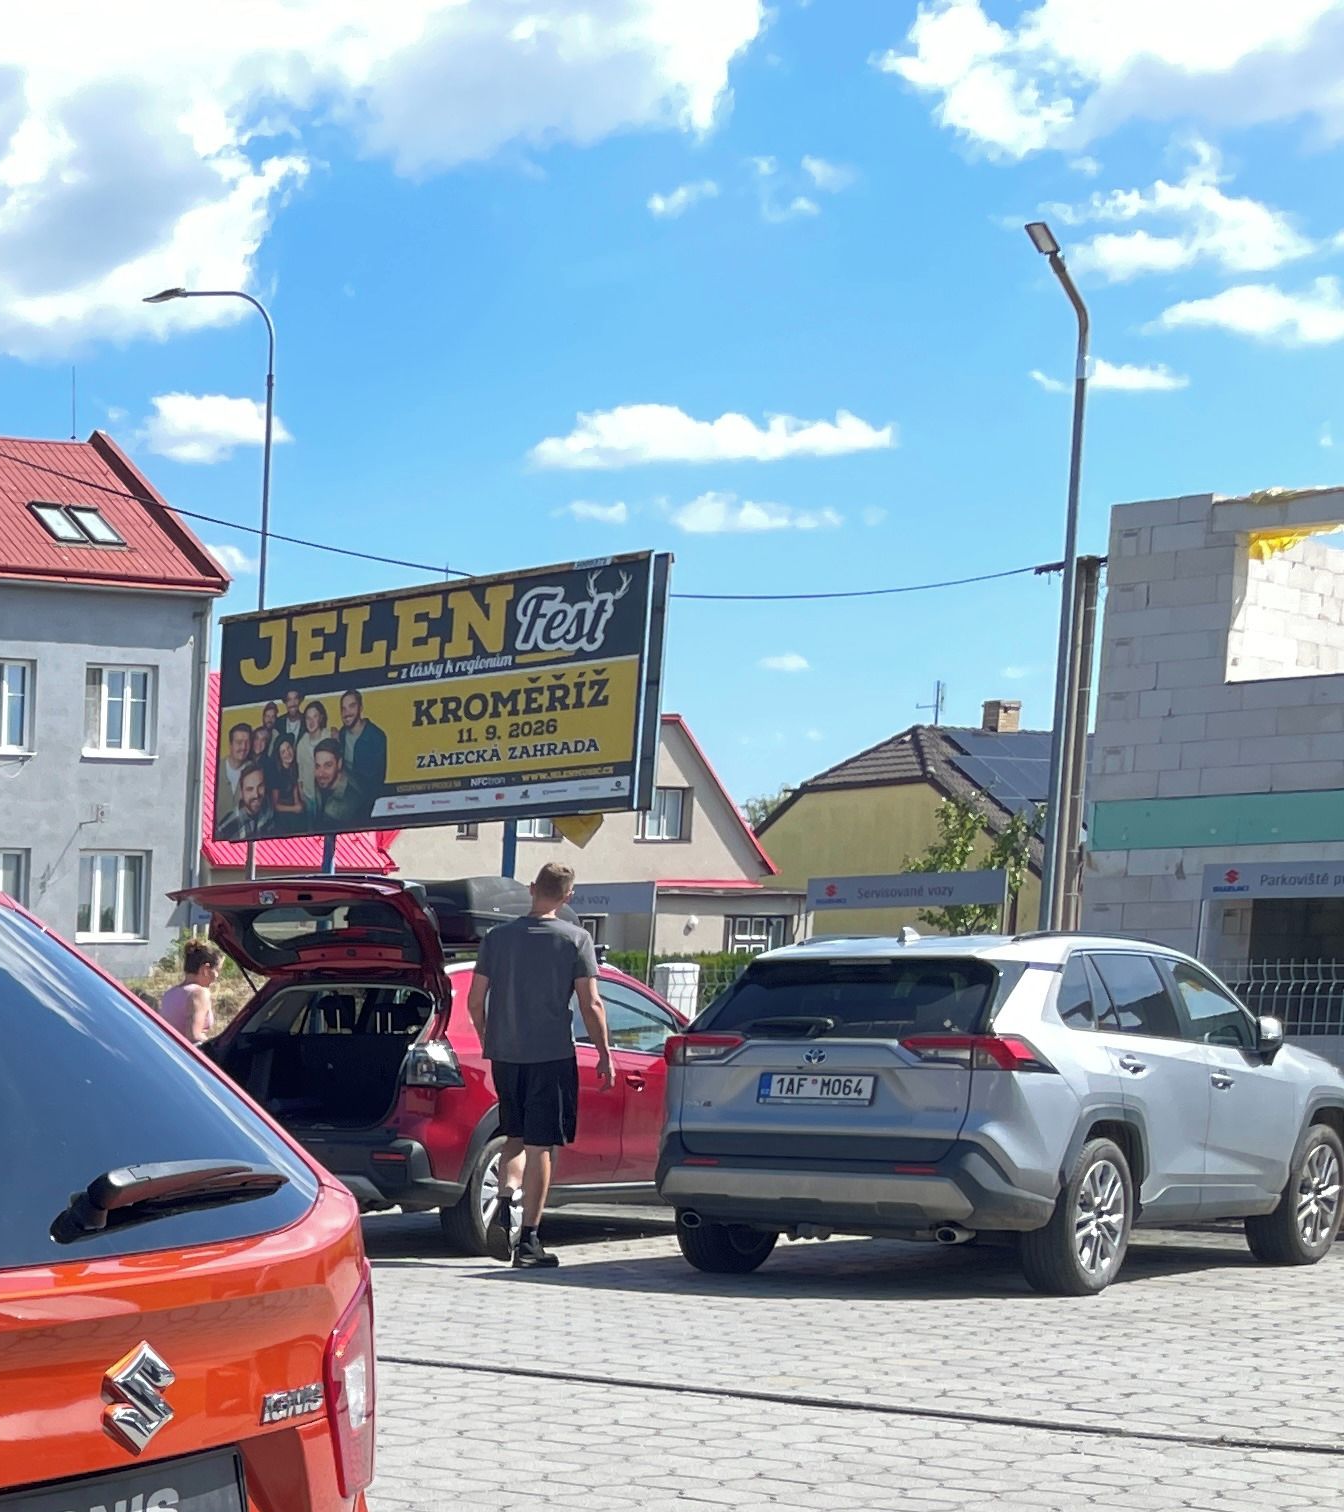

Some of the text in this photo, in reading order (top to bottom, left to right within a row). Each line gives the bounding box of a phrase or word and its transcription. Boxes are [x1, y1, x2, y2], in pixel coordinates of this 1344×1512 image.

[240, 584, 612, 686] JELEN Fest
[410, 661, 444, 680] lásky
[444, 659, 454, 674] k
[454, 654, 513, 678] regionům
[412, 667, 610, 728] KROMĚŘÍŽ
[457, 718, 558, 744] 11. 9. 2026
[416, 738, 600, 769] ZÁMECKÁ ZAHRADA
[857, 885, 954, 900] Servisované vozy
[1260, 872, 1329, 887] Parkoviště
[776, 1077, 864, 1096] 1AF M064
[259, 1383, 324, 1426] IGNIS
